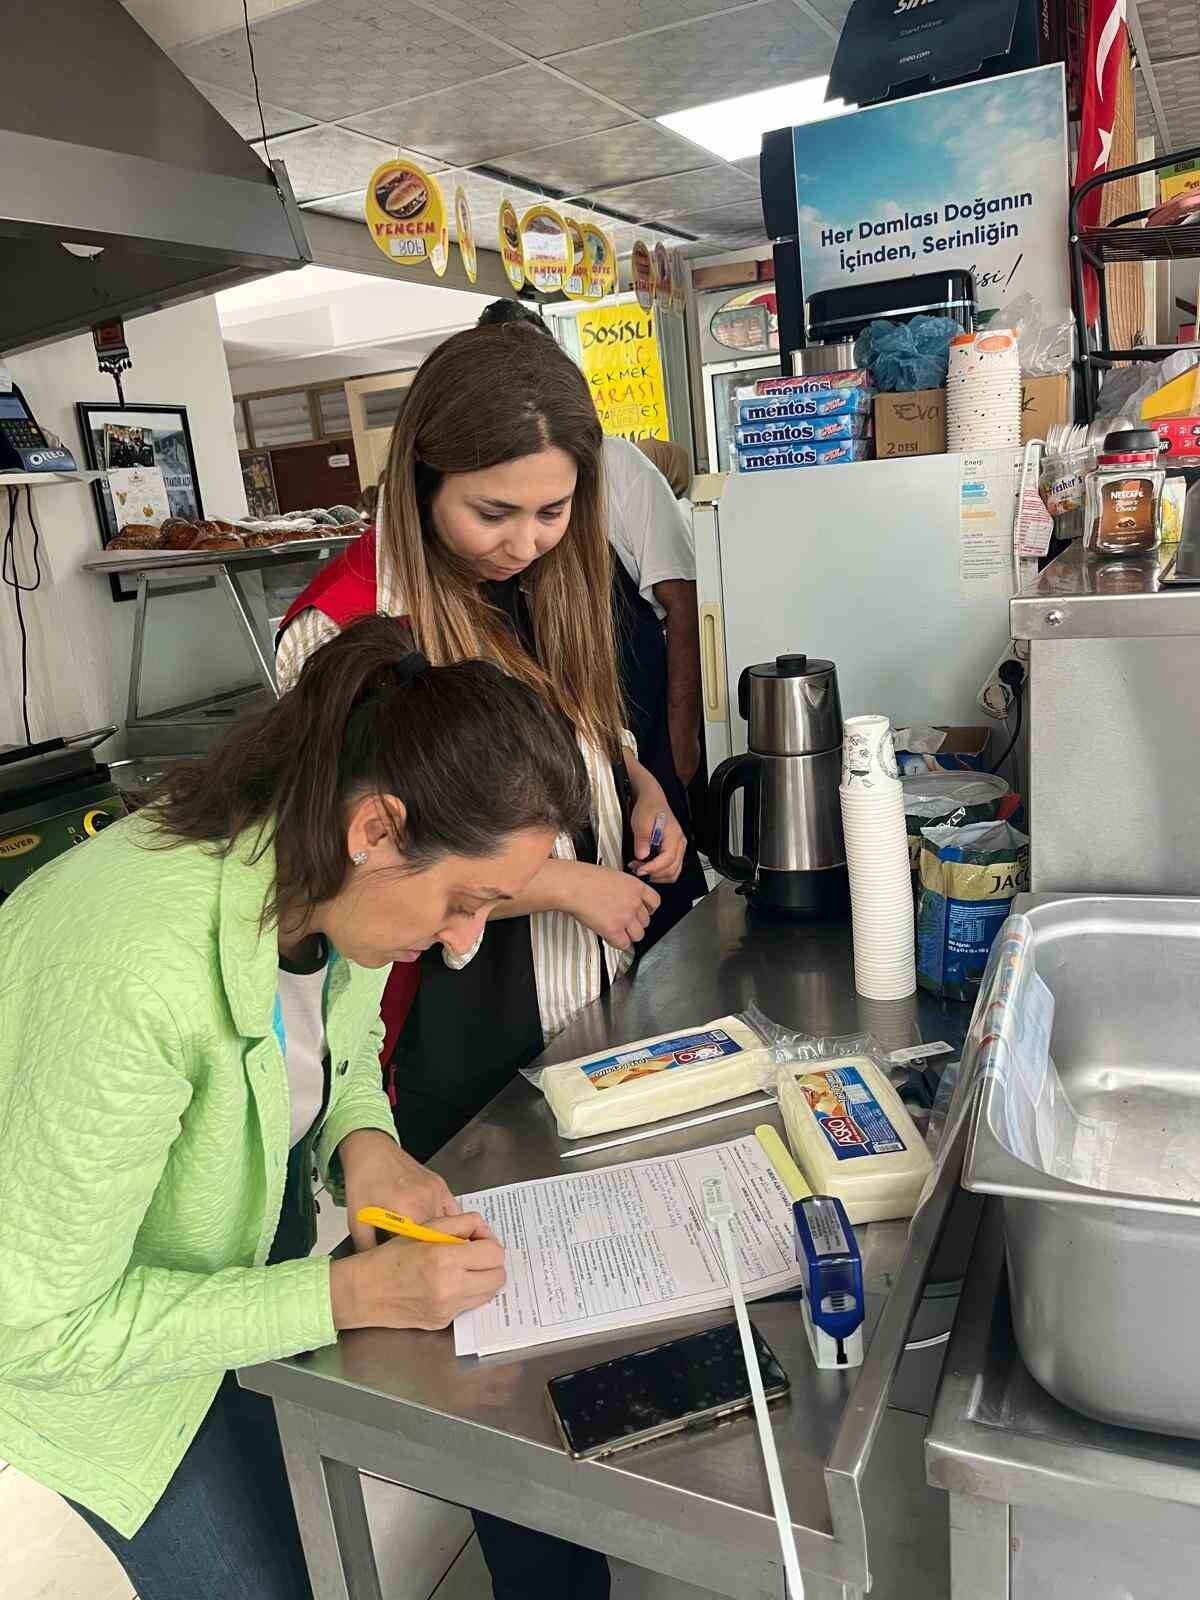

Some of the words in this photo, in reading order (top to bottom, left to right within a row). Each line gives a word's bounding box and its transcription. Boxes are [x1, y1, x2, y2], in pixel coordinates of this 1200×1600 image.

[374, 221, 436, 236] YENGEN
[820, 229, 853, 247] Her
[858, 211, 939, 240] Damlası
[944, 192, 1033, 222] Doğanın
[840, 244, 917, 273] İçinden,
[922, 221, 1019, 254] Serinliğin
[591, 366, 651, 386] EKMEK
[595, 381, 656, 406] ARASI
[747, 400, 817, 421] mentos
[742, 424, 814, 445] mentos
[30, 451, 65, 466] OREO
[744, 447, 816, 469] mentos
[886, 442, 897, 455] 2
[989, 870, 1030, 895] JAC
